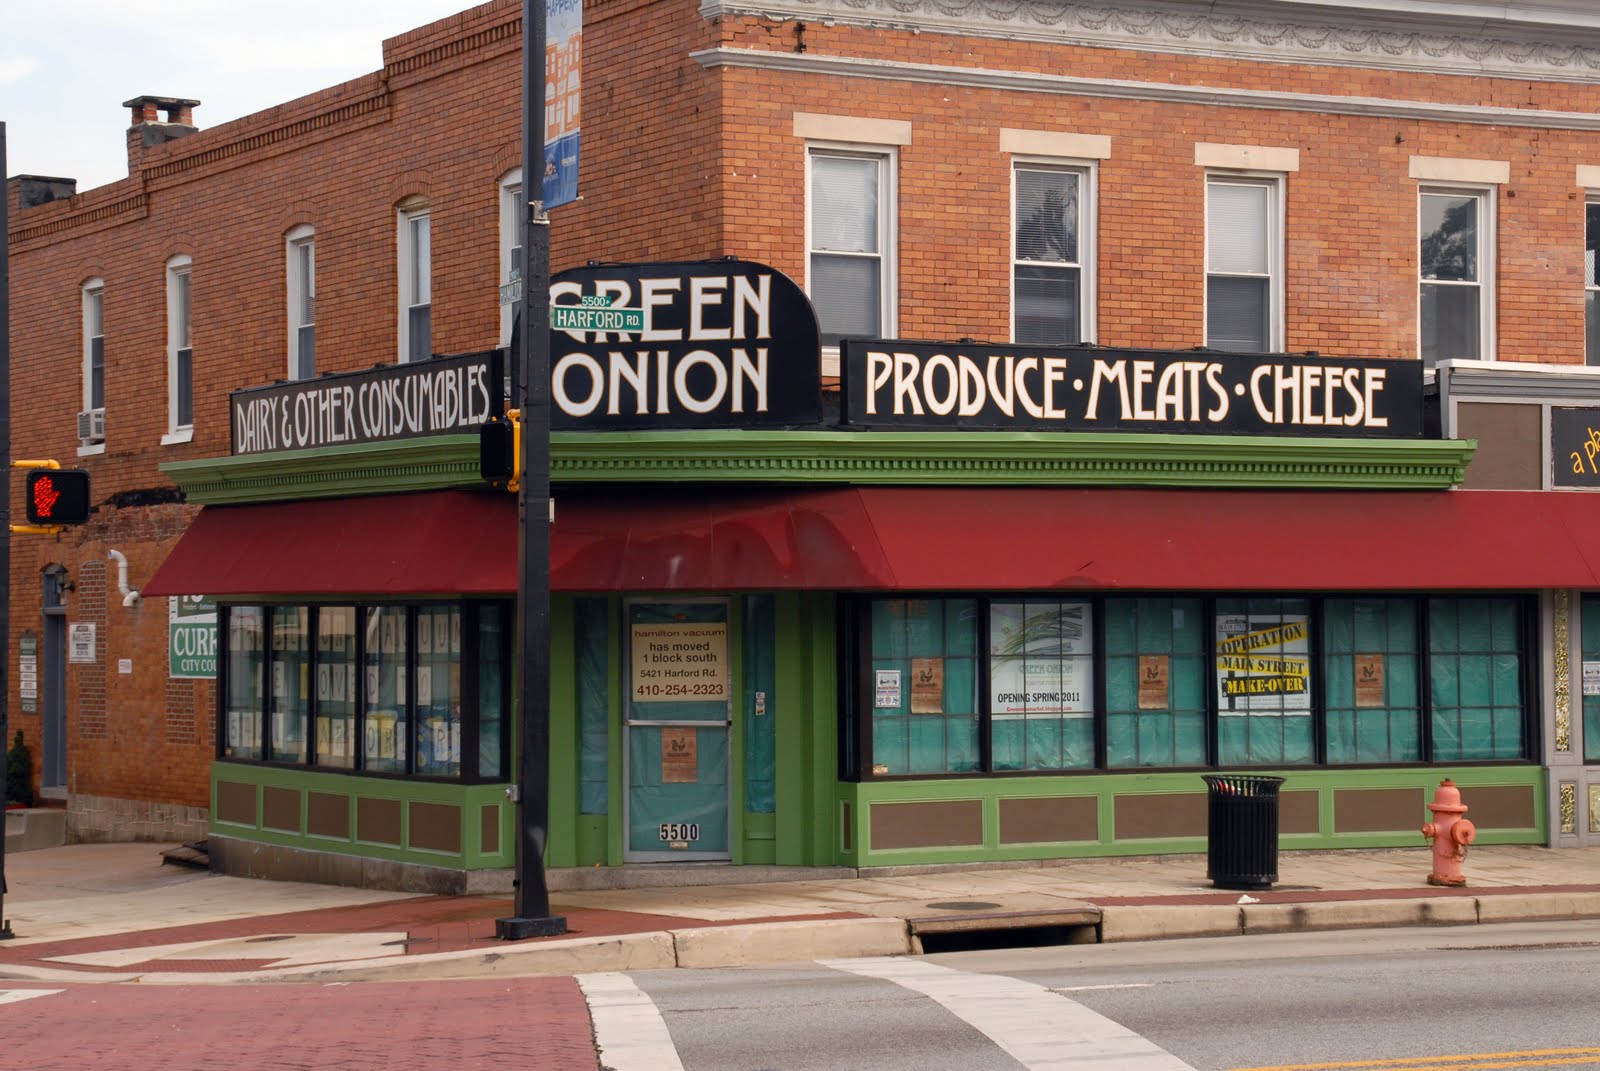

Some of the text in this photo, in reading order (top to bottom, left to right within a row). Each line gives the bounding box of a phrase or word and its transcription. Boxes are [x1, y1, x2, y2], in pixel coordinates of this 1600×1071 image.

[582, 296, 606, 307] 5500
[557, 310, 640, 328] HARFORD RD.
[551, 347, 769, 417] ONION
[866, 351, 1389, 428] PRODUCE MEATS CHEESE
[237, 396, 278, 453] DAIRY
[295, 386, 356, 447] OTHER
[359, 363, 490, 438] CONSUMABLES
[1570, 451, 1585, 474] a
[634, 629, 725, 638] hamilton vacuum
[1221, 625, 1302, 653] OPERATION
[649, 641, 710, 651] has moved
[181, 659, 200, 672] CITY
[643, 652, 717, 663] 1 block south
[1223, 656, 1304, 675] MAIN STREET
[640, 668, 718, 678] 5421 Harford Rd.
[636, 683, 724, 695] 410-254-2323
[1227, 677, 1304, 694] MAKE-OVER
[997, 692, 1080, 703] OPENING SPRING 2011
[661, 824, 698, 840] 5500
